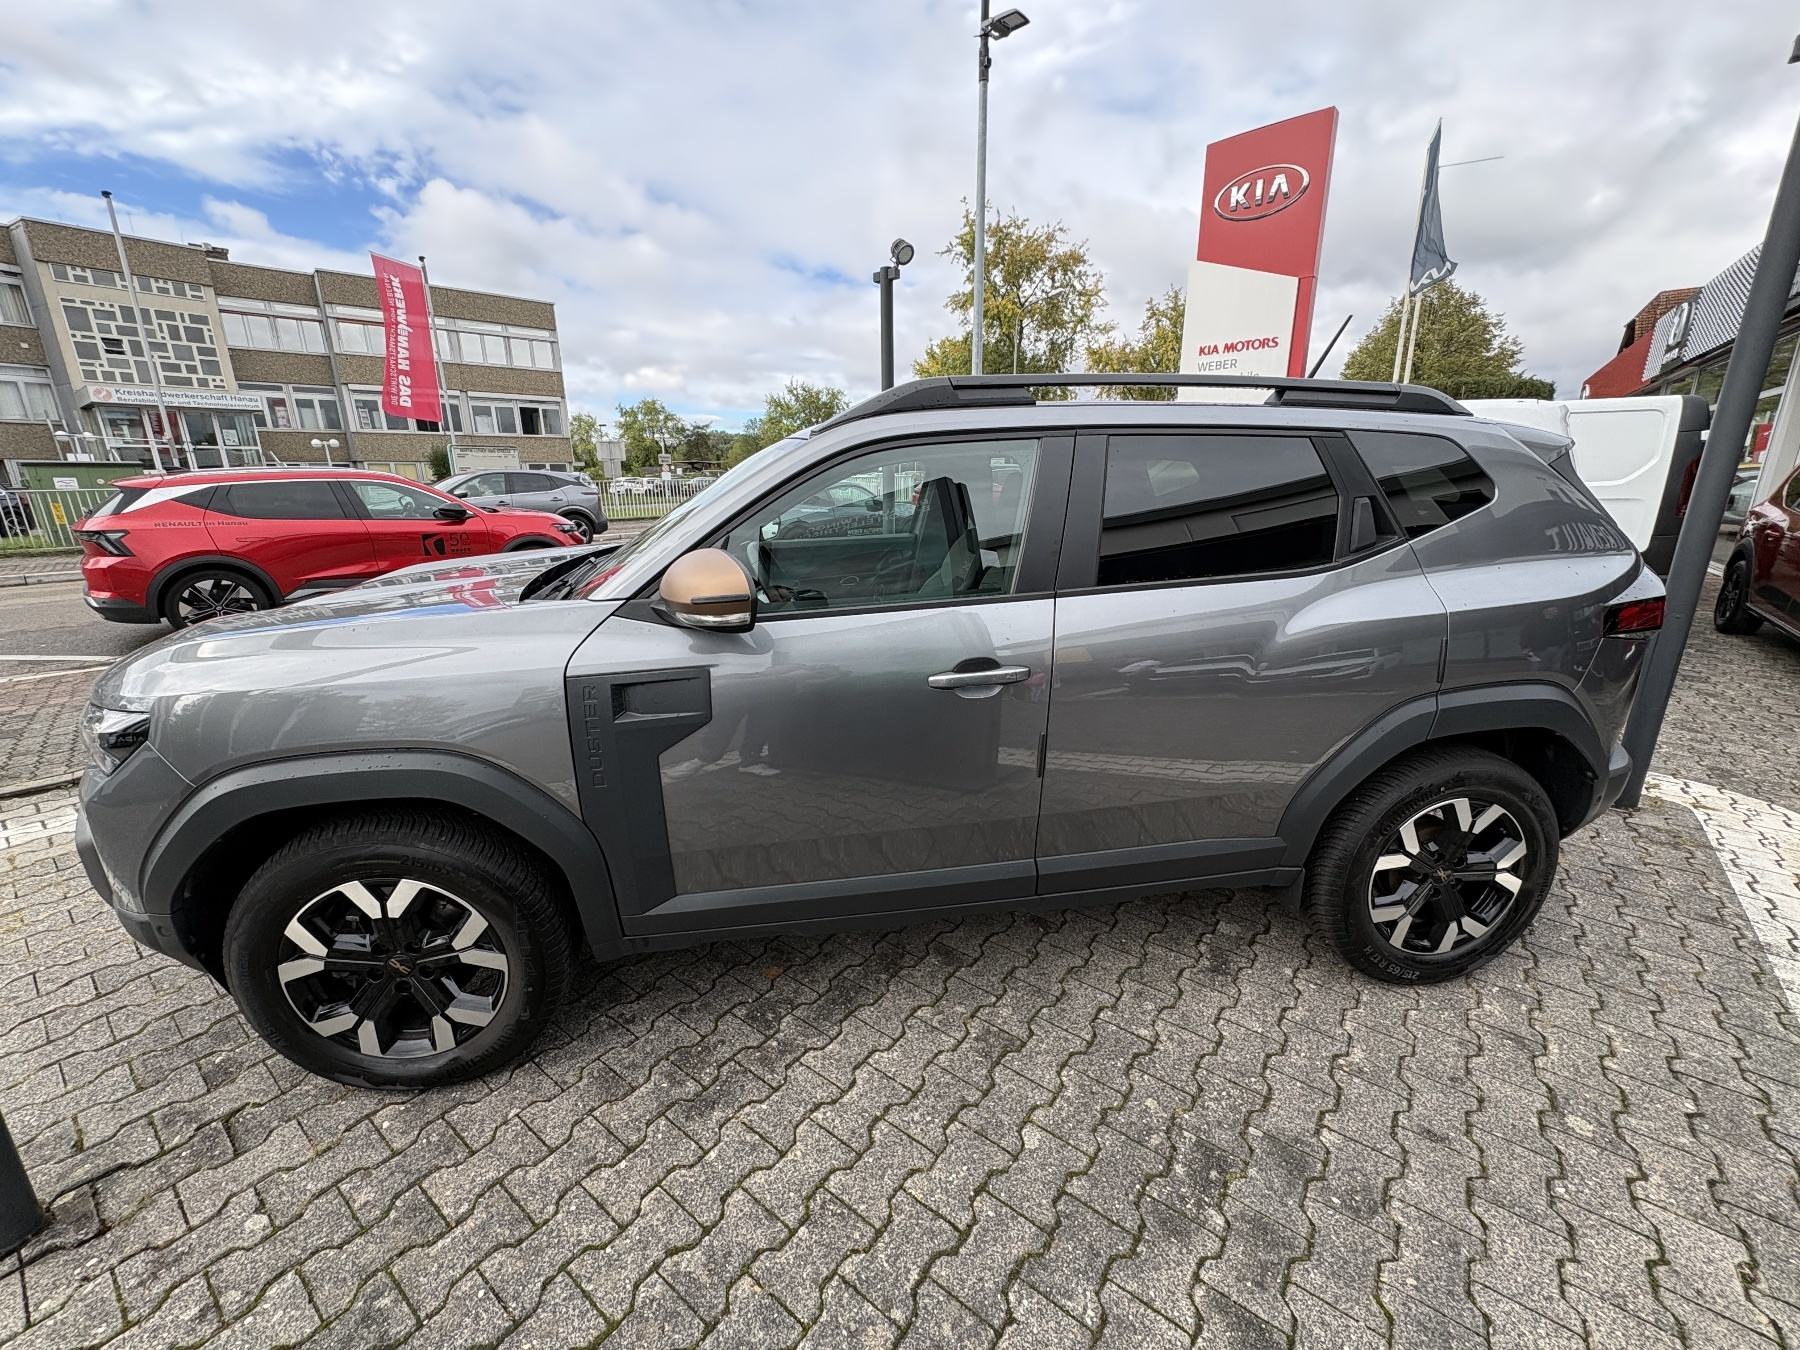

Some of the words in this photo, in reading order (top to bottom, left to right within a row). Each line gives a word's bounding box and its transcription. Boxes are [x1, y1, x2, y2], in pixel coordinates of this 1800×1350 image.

[1229, 173, 1291, 213] KIA
[1198, 343, 1220, 357] KIA
[1222, 335, 1280, 355] MOTORS
[1196, 357, 1239, 373] WEBER
[229, 394, 259, 403] Hanau
[154, 520, 203, 528] RENAULT
[583, 685, 608, 788] DUSTER
[1386, 963, 1420, 980] 215/65
